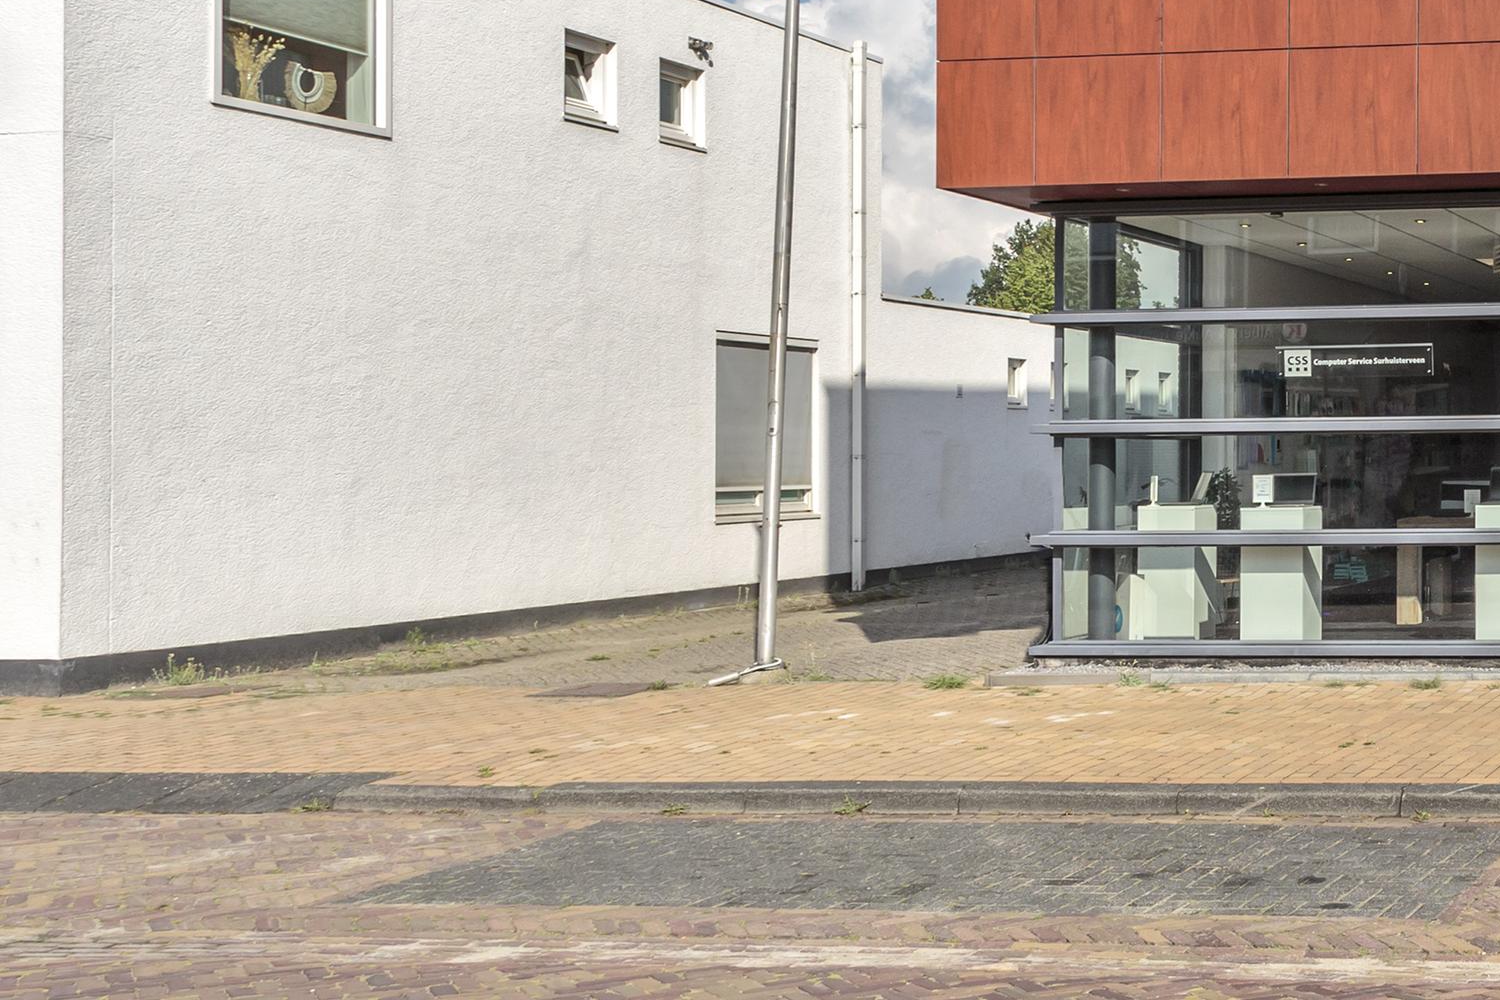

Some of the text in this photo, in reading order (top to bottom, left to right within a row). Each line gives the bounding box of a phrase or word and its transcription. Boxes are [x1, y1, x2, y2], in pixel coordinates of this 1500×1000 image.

[1287, 356, 1309, 365] CSS
[1313, 356, 1426, 367] Computer Service Surhuisterveen
